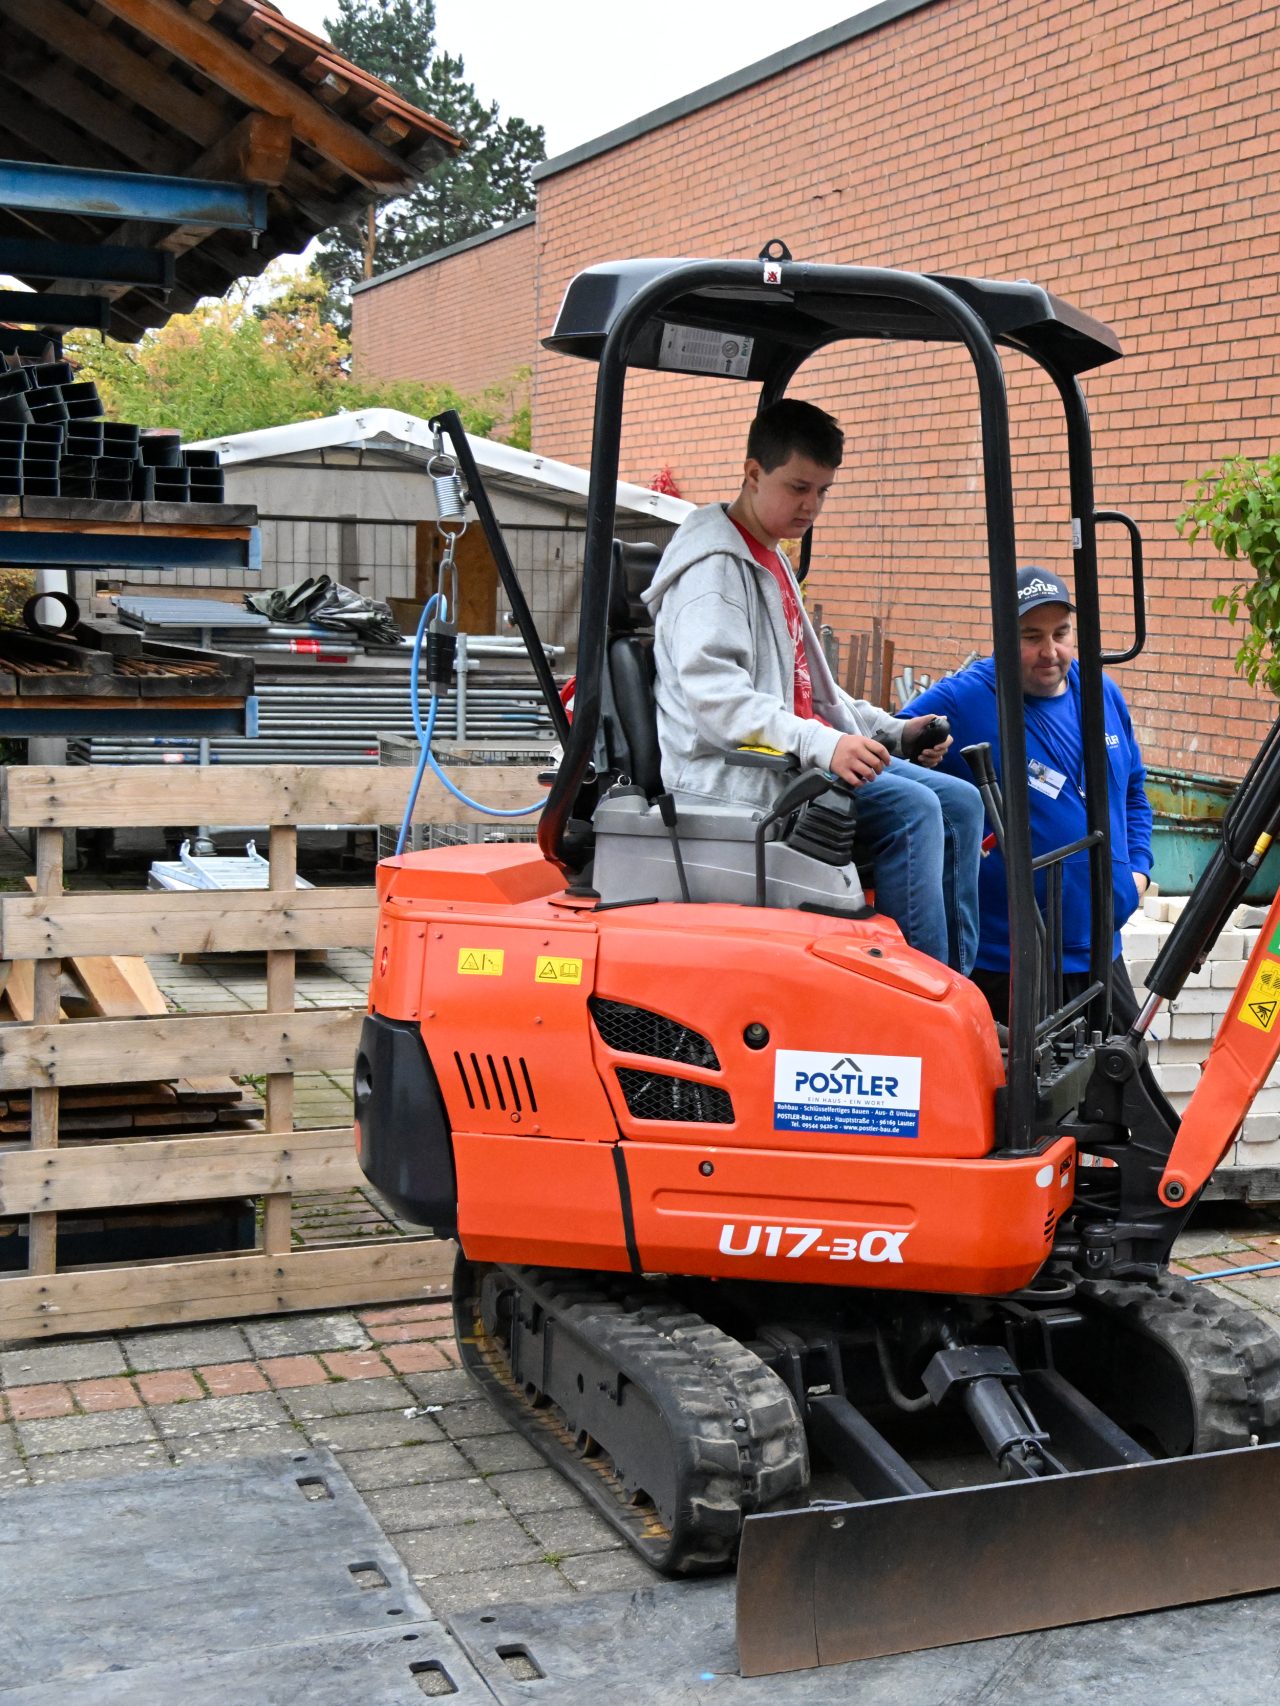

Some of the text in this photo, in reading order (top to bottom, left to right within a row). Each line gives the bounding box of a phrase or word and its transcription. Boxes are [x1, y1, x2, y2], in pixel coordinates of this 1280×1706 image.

[1017, 583, 1060, 600] POSTLER
[795, 1071, 899, 1098] POSTLER
[803, 1105, 850, 1115] Schlüsselfertiges
[896, 1110, 916, 1118] Umbau
[777, 1113, 813, 1121] POSTLER-Bau
[835, 1116, 870, 1125] Hauptstraße
[897, 1119, 916, 1127] Lauter
